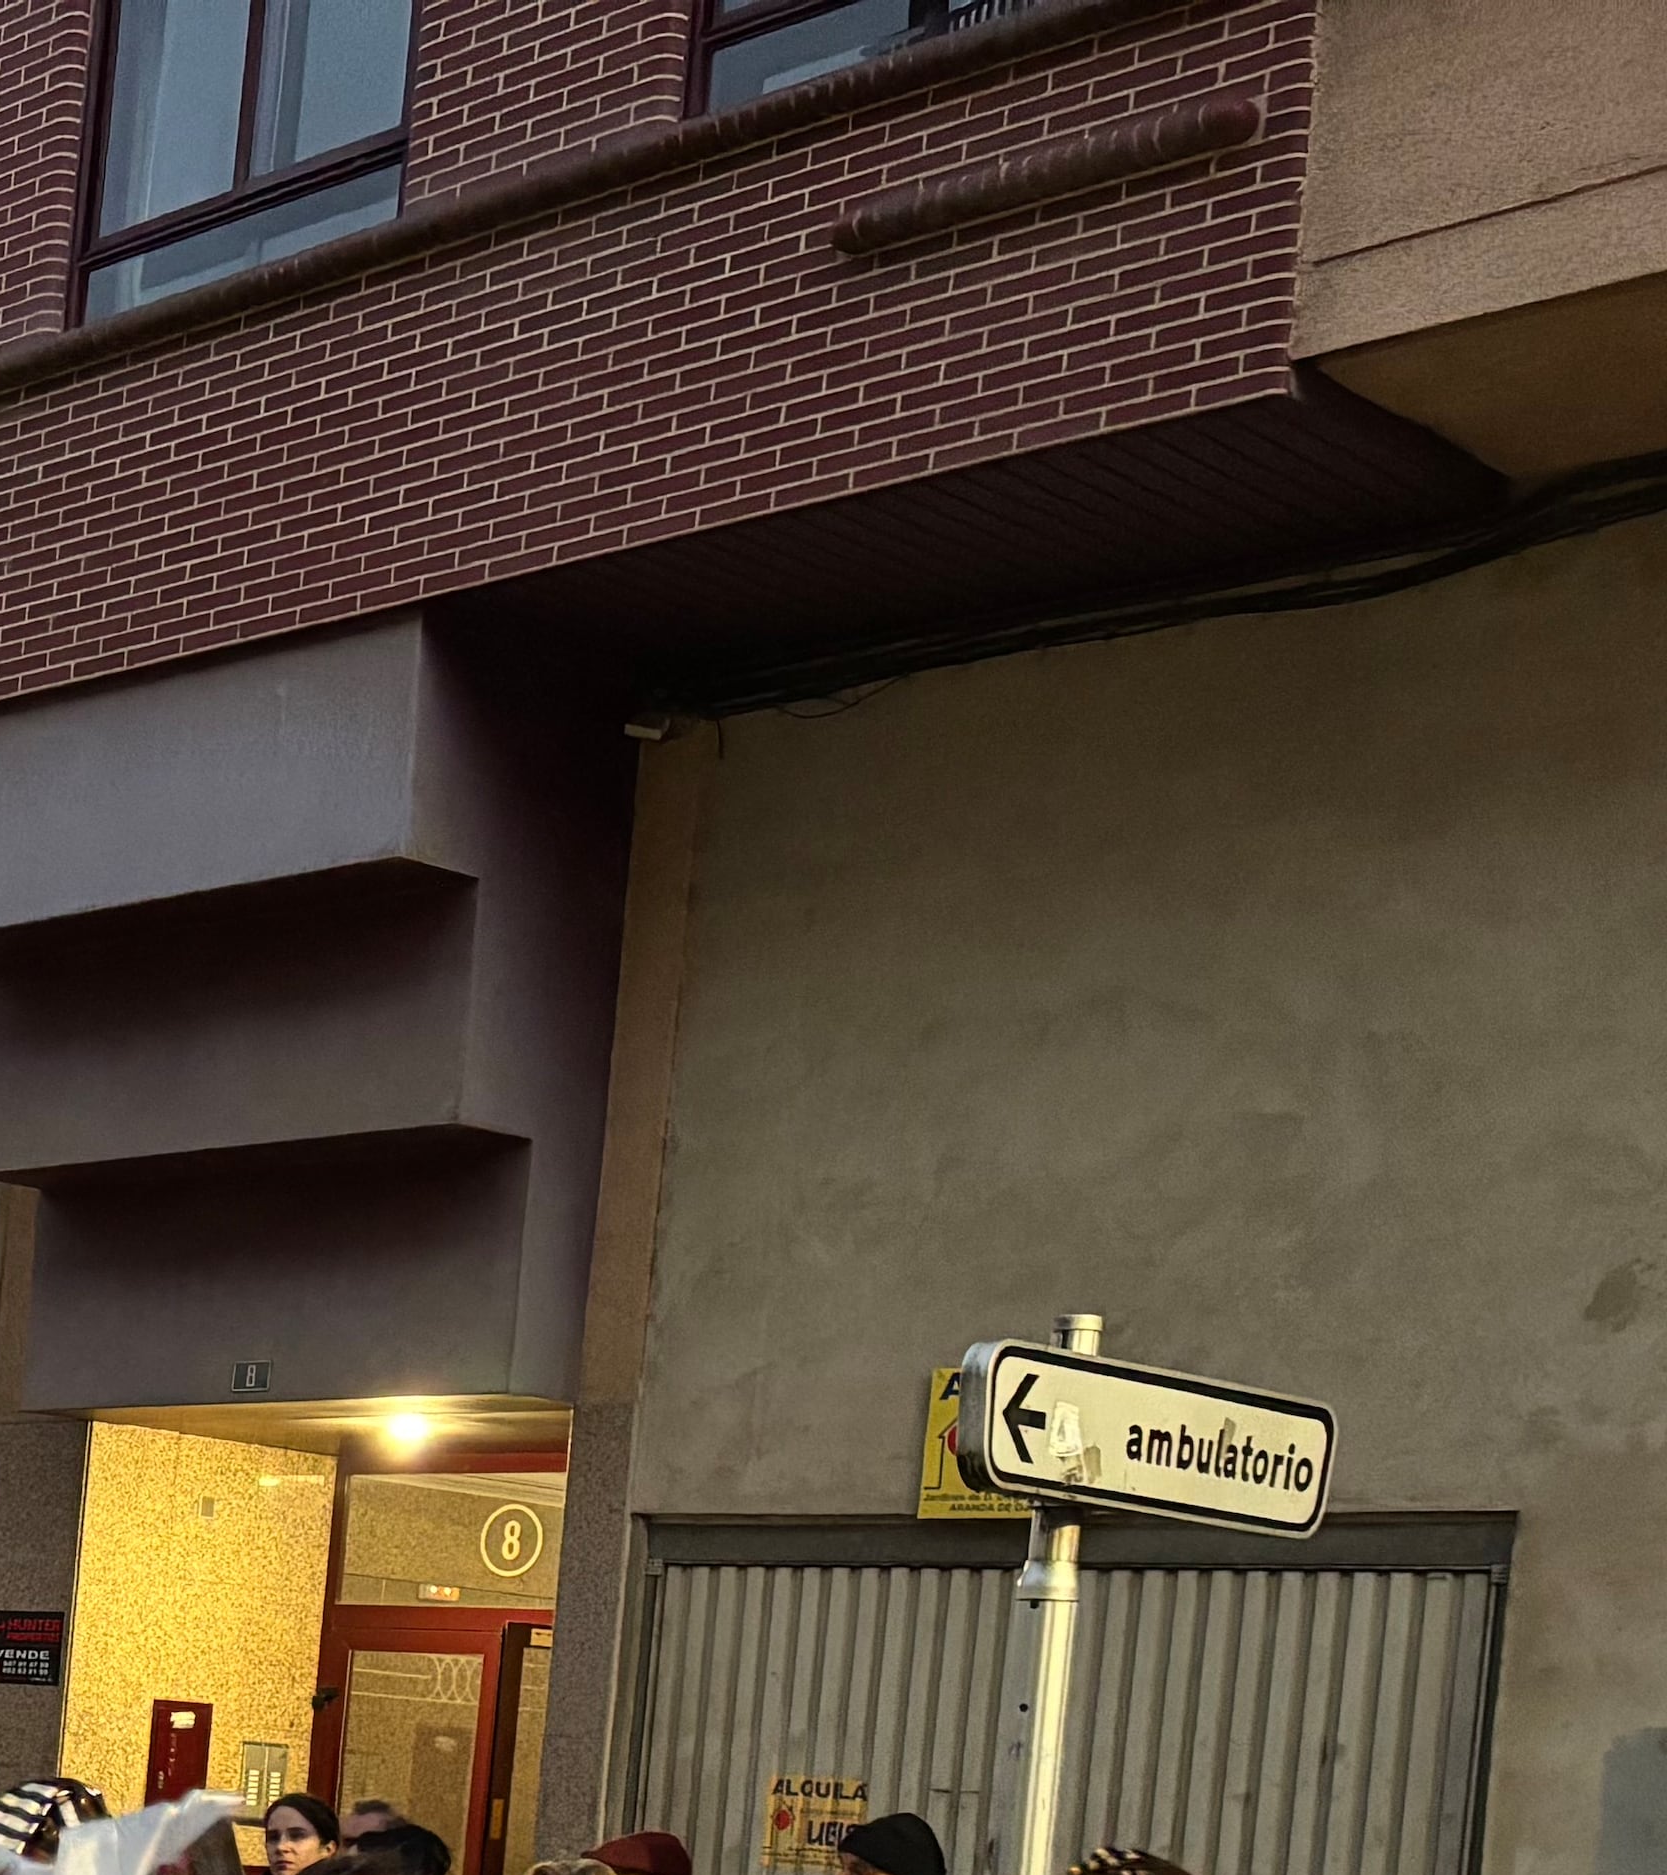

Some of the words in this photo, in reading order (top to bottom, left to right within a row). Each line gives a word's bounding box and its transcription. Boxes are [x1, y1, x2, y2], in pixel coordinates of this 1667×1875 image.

[246, 1364, 256, 1387] 8
[1126, 1424, 1313, 1492] ambulatorio
[502, 1520, 521, 1560] 8
[771, 1779, 867, 1801] ALQUILA
